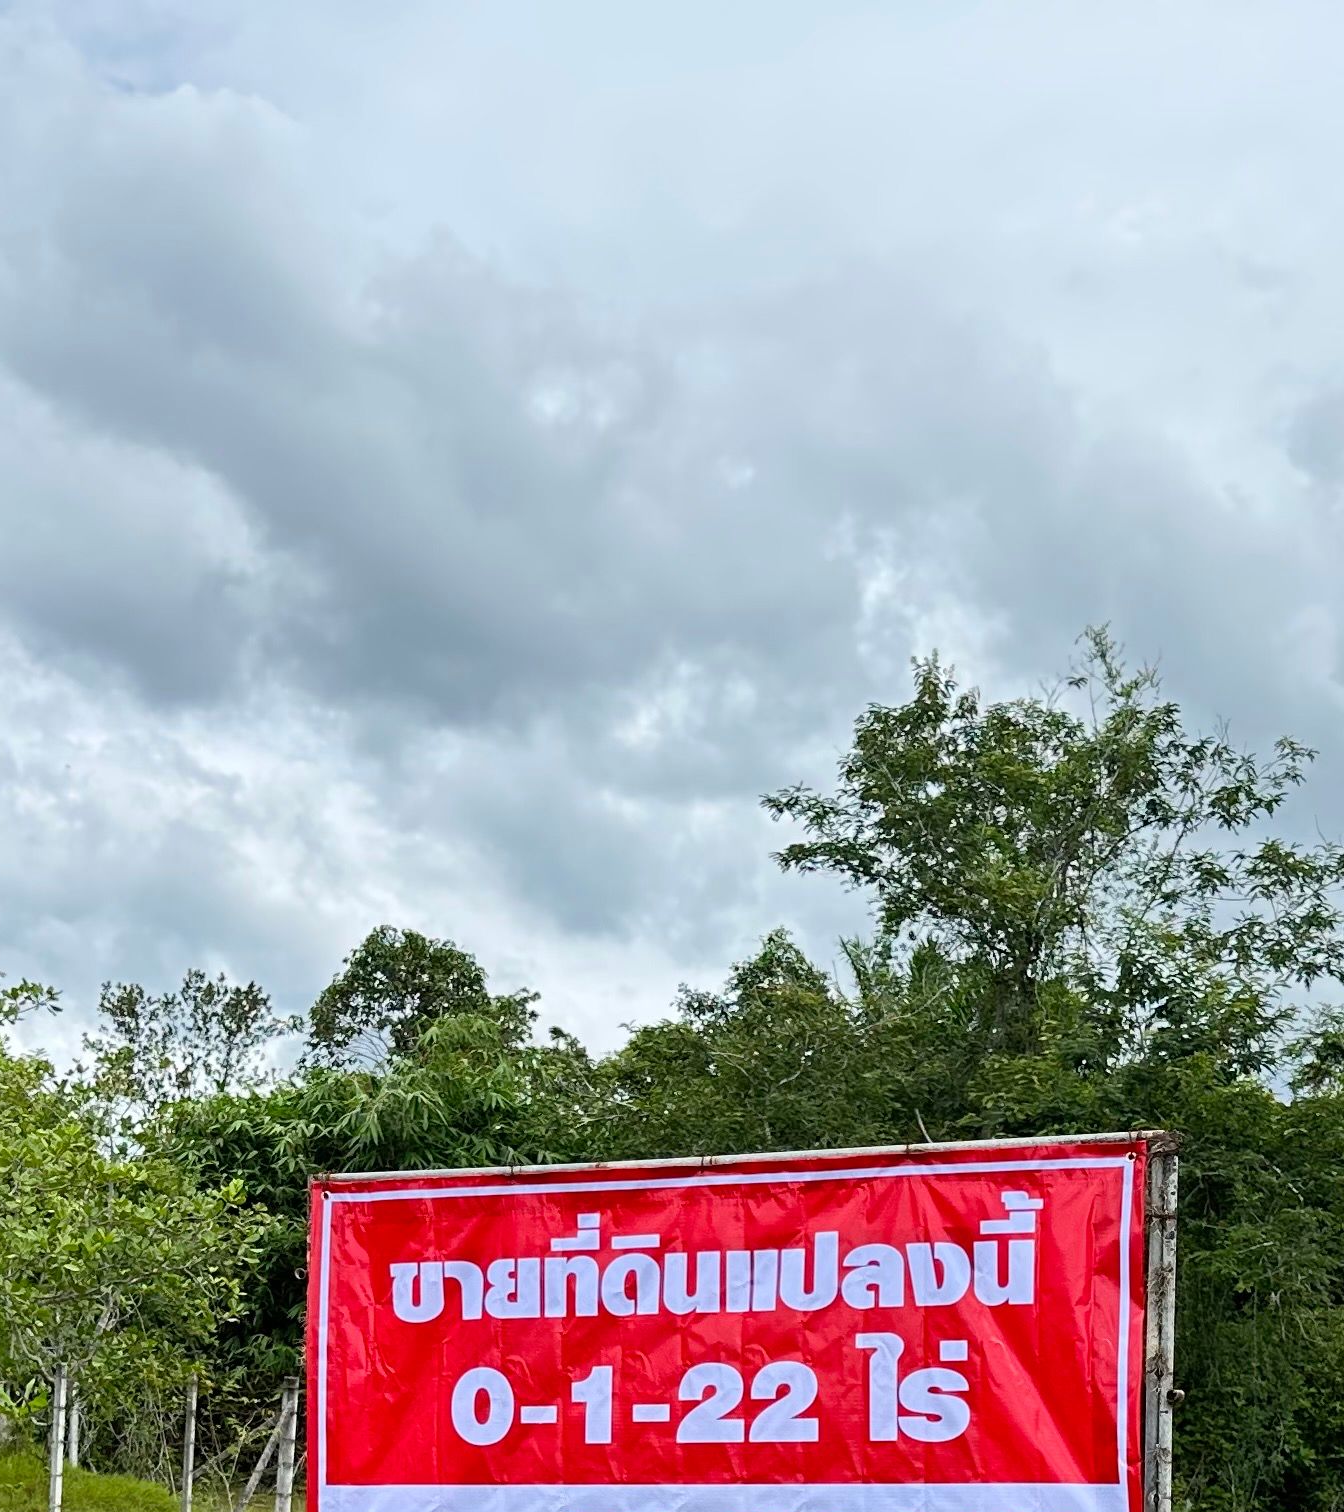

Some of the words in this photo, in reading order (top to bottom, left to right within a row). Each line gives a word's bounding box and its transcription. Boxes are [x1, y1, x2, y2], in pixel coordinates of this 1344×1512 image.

[389, 1190, 1044, 1324] ขายที่ดินแปลงนี้
[451, 1361, 820, 1446] 0-1-22
[855, 1331, 970, 1444] ไร่
